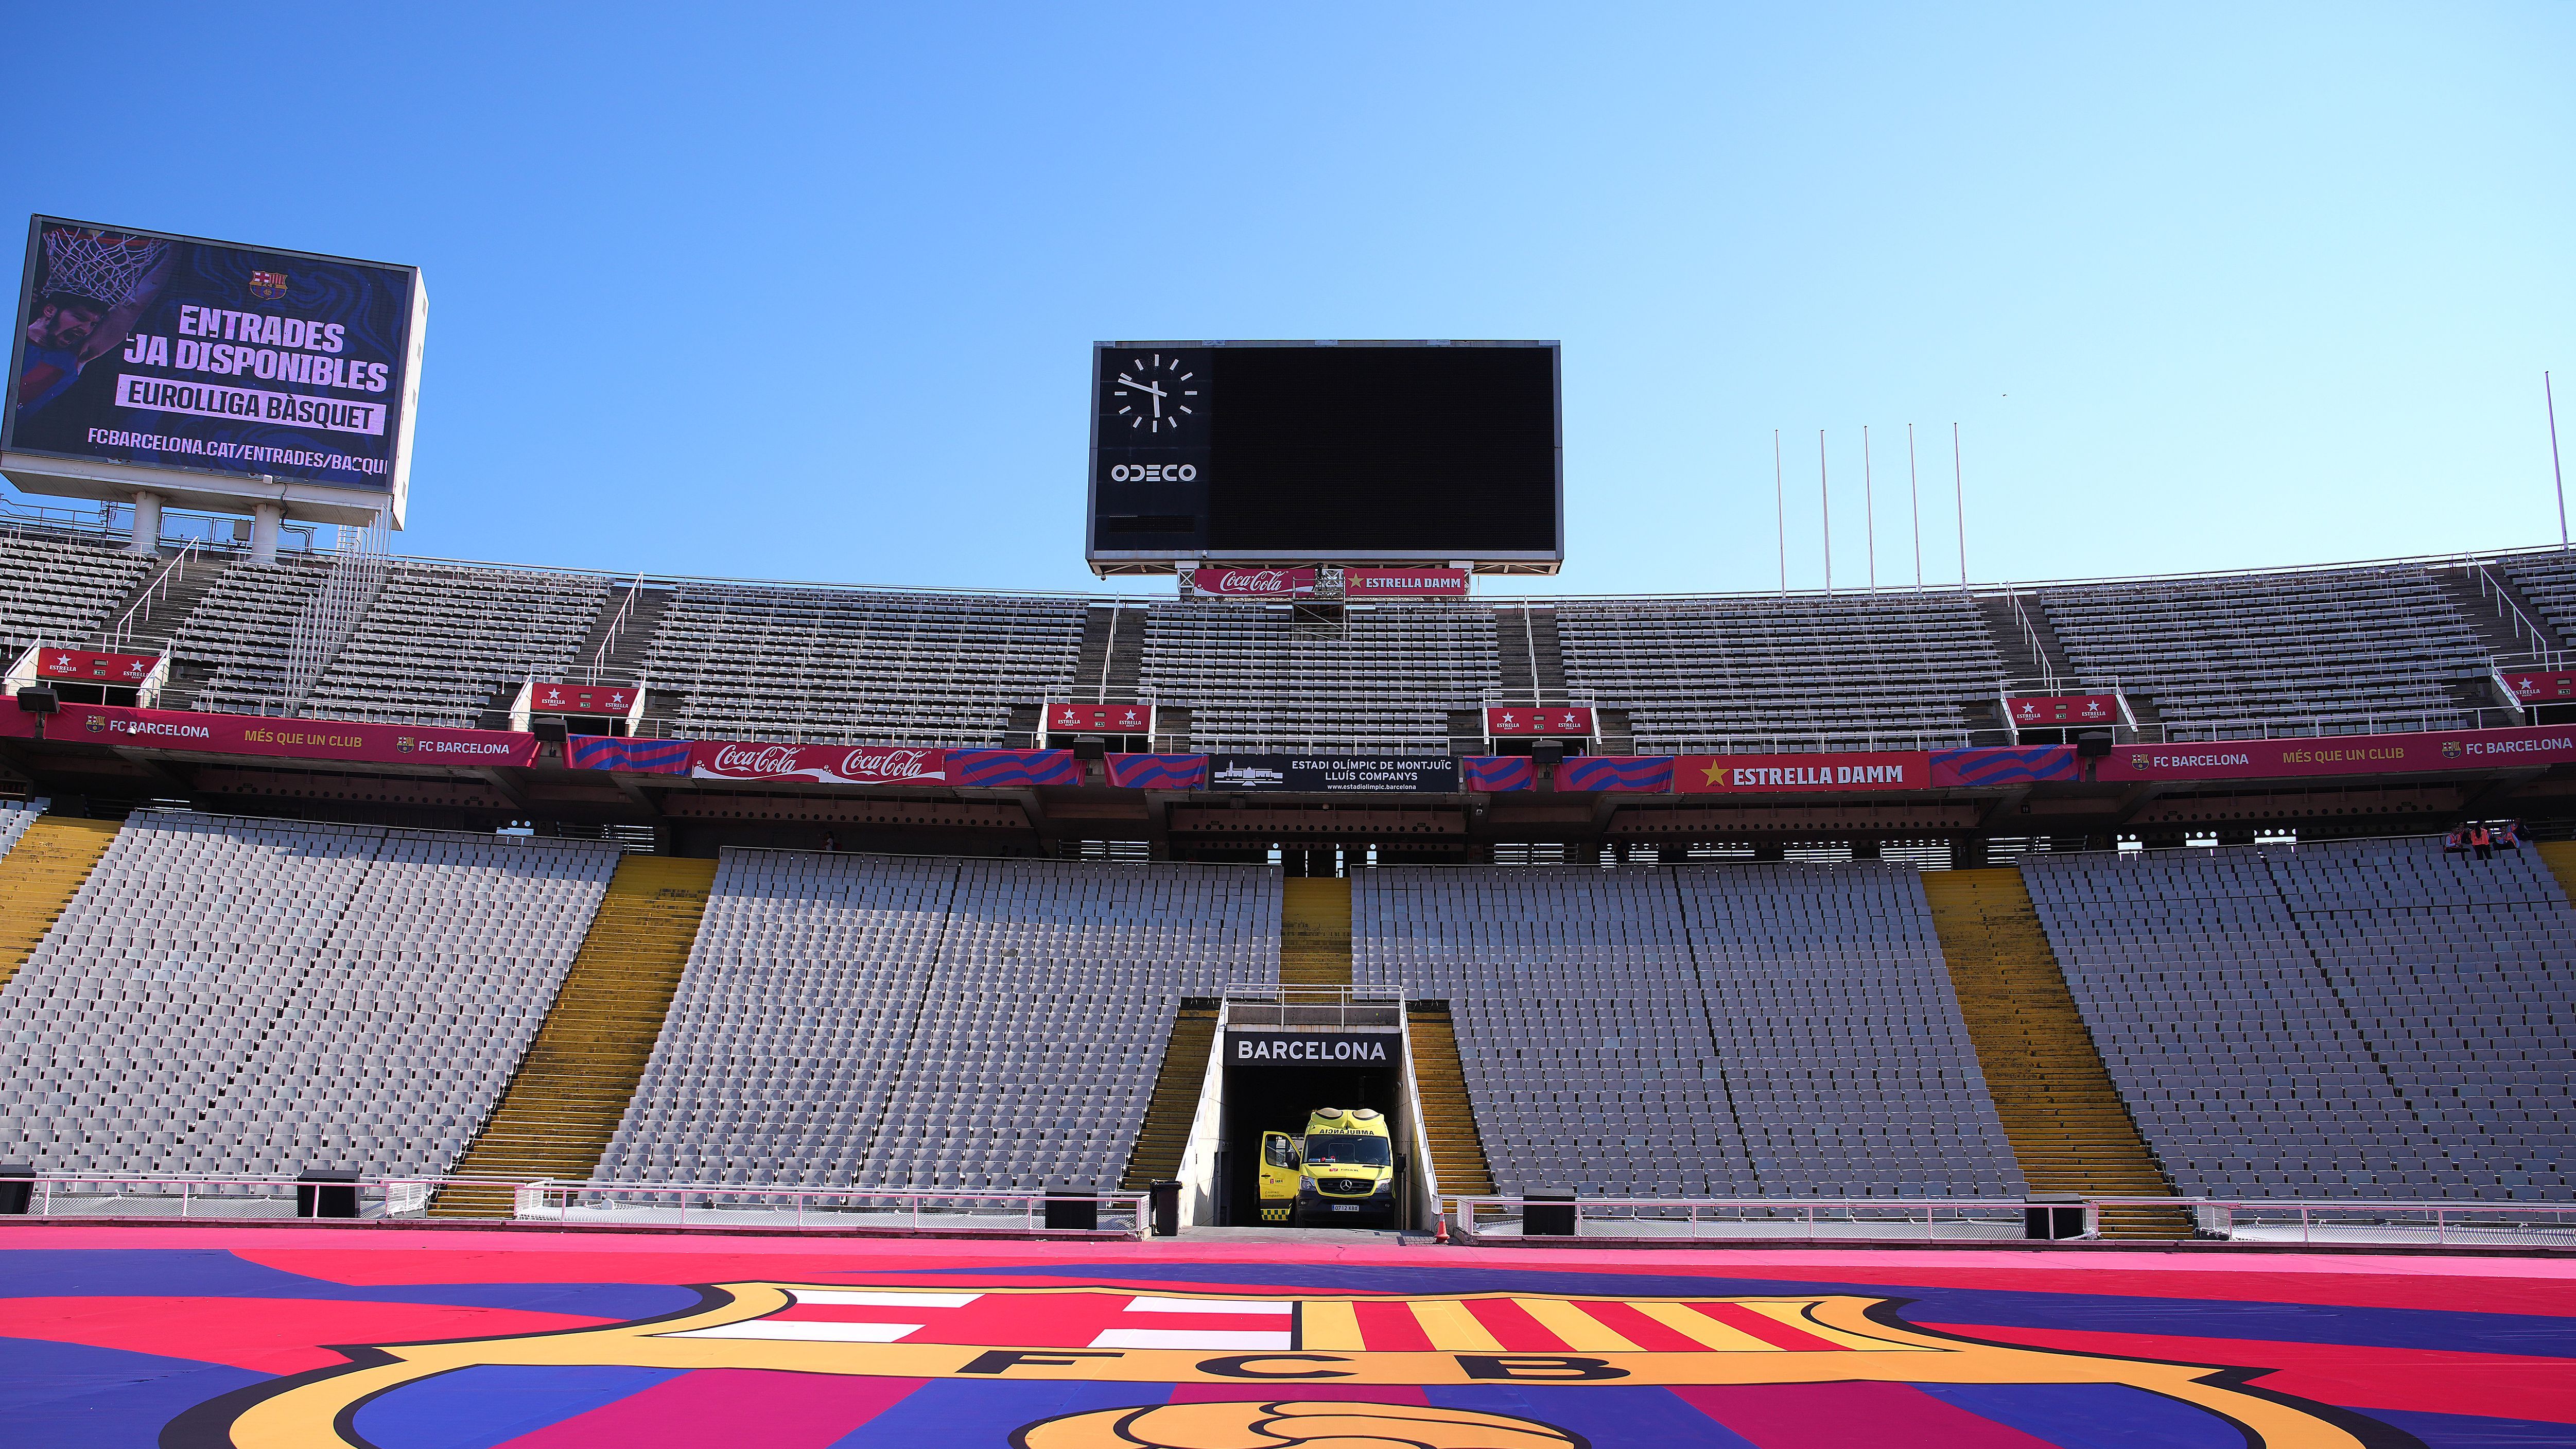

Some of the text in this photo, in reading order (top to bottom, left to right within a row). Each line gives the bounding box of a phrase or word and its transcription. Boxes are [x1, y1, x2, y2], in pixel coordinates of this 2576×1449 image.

[179, 304, 345, 353] ENTRADES
[124, 334, 389, 392] JA DISPONIBLES
[128, 380, 375, 429] EUROLLIGA BÀSQUET
[1111, 464, 1197, 482] ODECO
[1220, 570, 1286, 592] Coca-Cola
[1366, 578, 1461, 588] ESTRELLA DAMM
[110, 720, 126, 731] FC
[245, 728, 362, 747] MÉS QUE UN CLUB
[2466, 738, 2573, 755] FC BARCELONA
[419, 741, 510, 754] FC BARCELONA
[2283, 747, 2404, 764] MÉS QUE UN CLUB
[714, 744, 802, 773] Coca-Cola
[841, 748, 928, 777] Coca-Cola
[1292, 759, 1452, 770] ESTADI OLÍMPIC DE MONTJUÏC
[2153, 754, 2249, 767] FC BARCELONA
[1325, 770, 1418, 780] LLUÍS COMPANYS
[1733, 765, 1903, 786] ESTRELLA DAMM
[1238, 1041, 1386, 1060] BARCELONA
